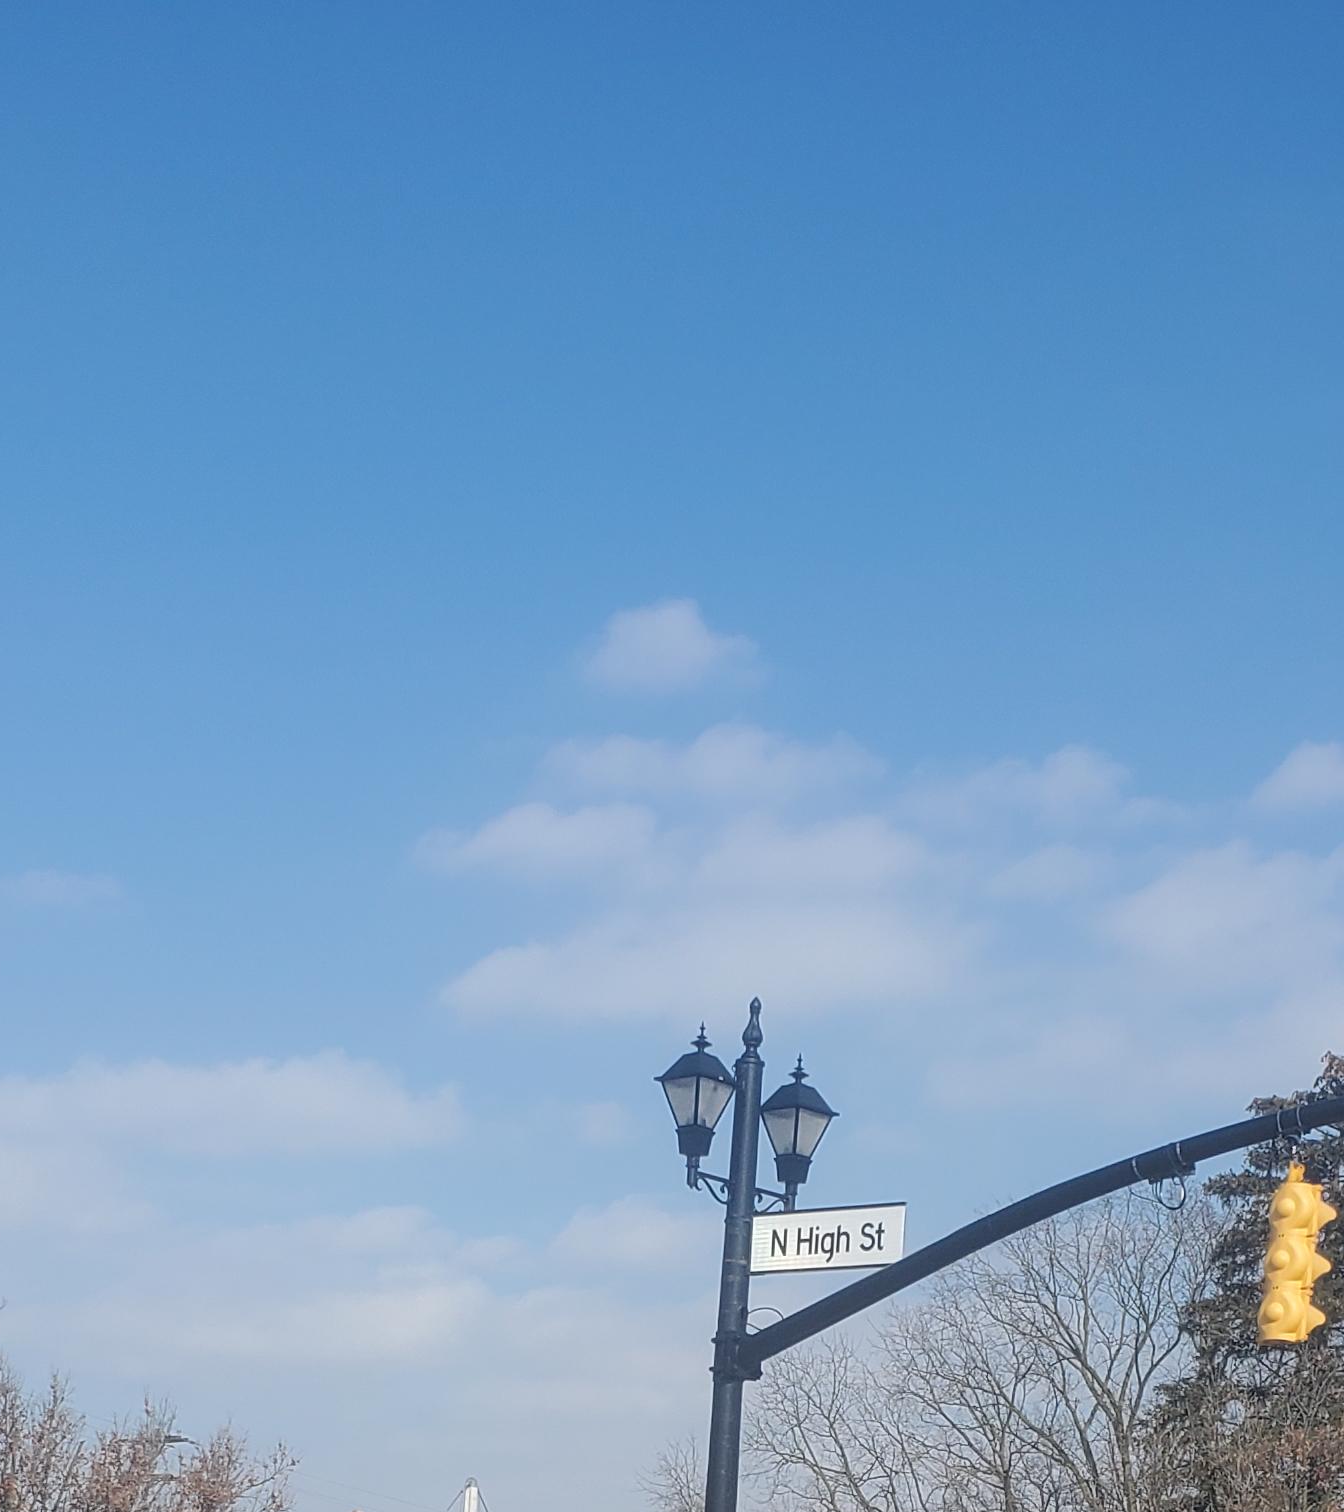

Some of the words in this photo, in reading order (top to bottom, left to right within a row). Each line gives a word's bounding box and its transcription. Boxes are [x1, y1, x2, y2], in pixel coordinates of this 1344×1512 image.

[771, 1228, 788, 1257] N
[796, 1224, 851, 1263] High
[859, 1222, 886, 1252] St
